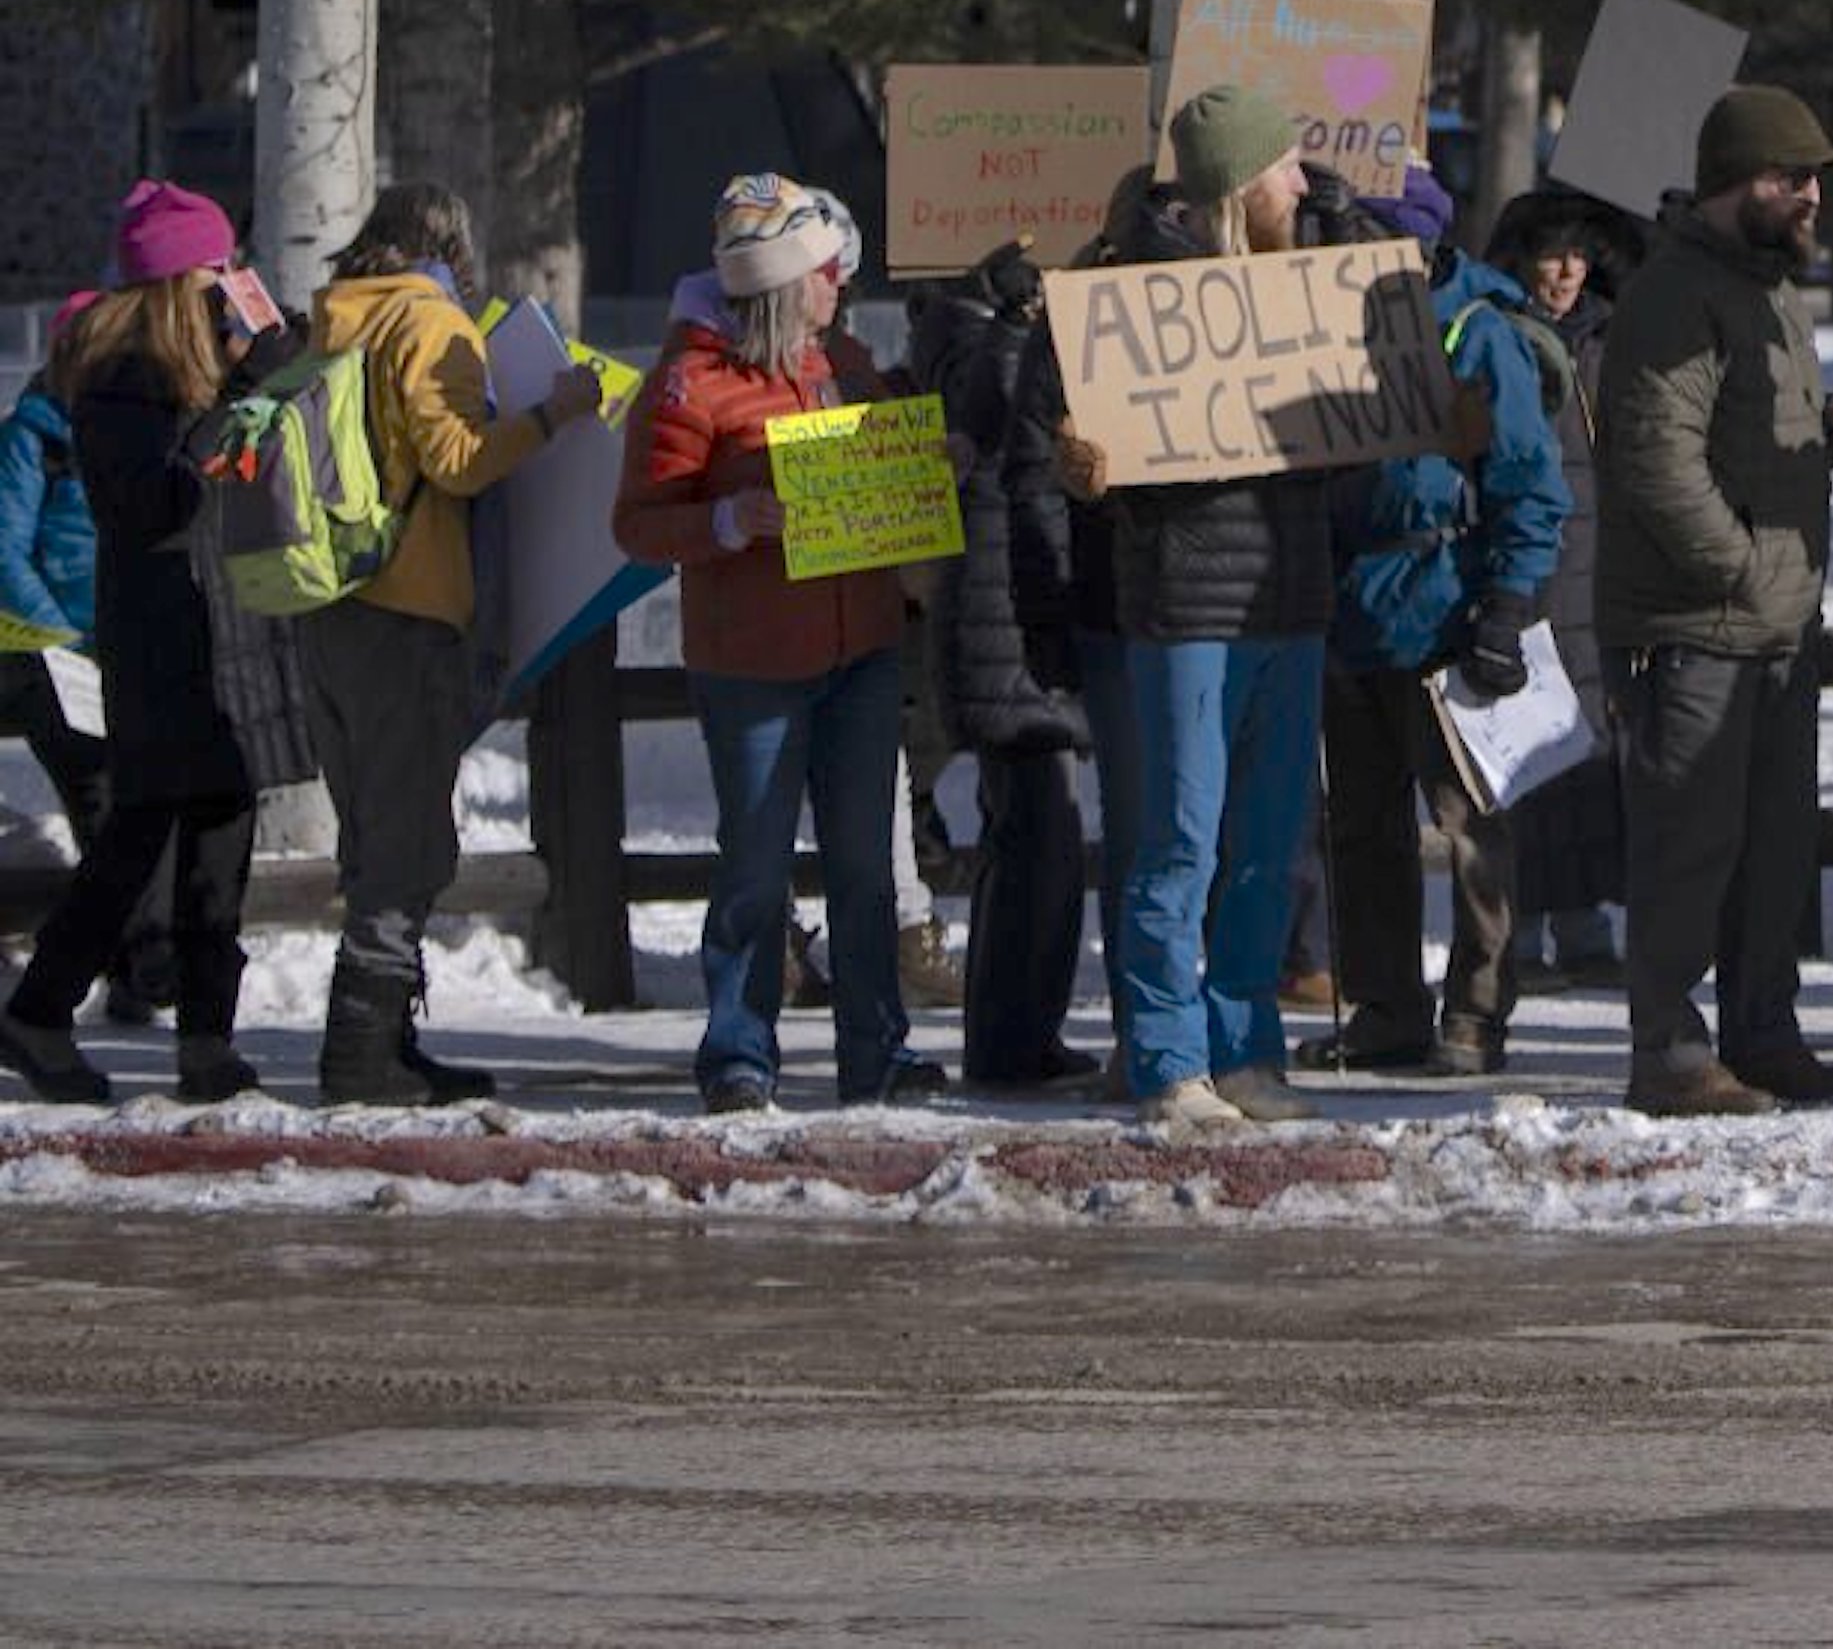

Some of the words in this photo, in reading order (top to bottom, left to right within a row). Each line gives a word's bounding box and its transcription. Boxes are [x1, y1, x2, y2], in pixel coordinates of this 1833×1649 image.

[907, 91, 1125, 142] Compassion
[1292, 115, 1406, 168] ome
[978, 148, 1046, 180] NOT
[1081, 247, 1423, 384] ABOLISH
[1307, 359, 1442, 452] NOW
